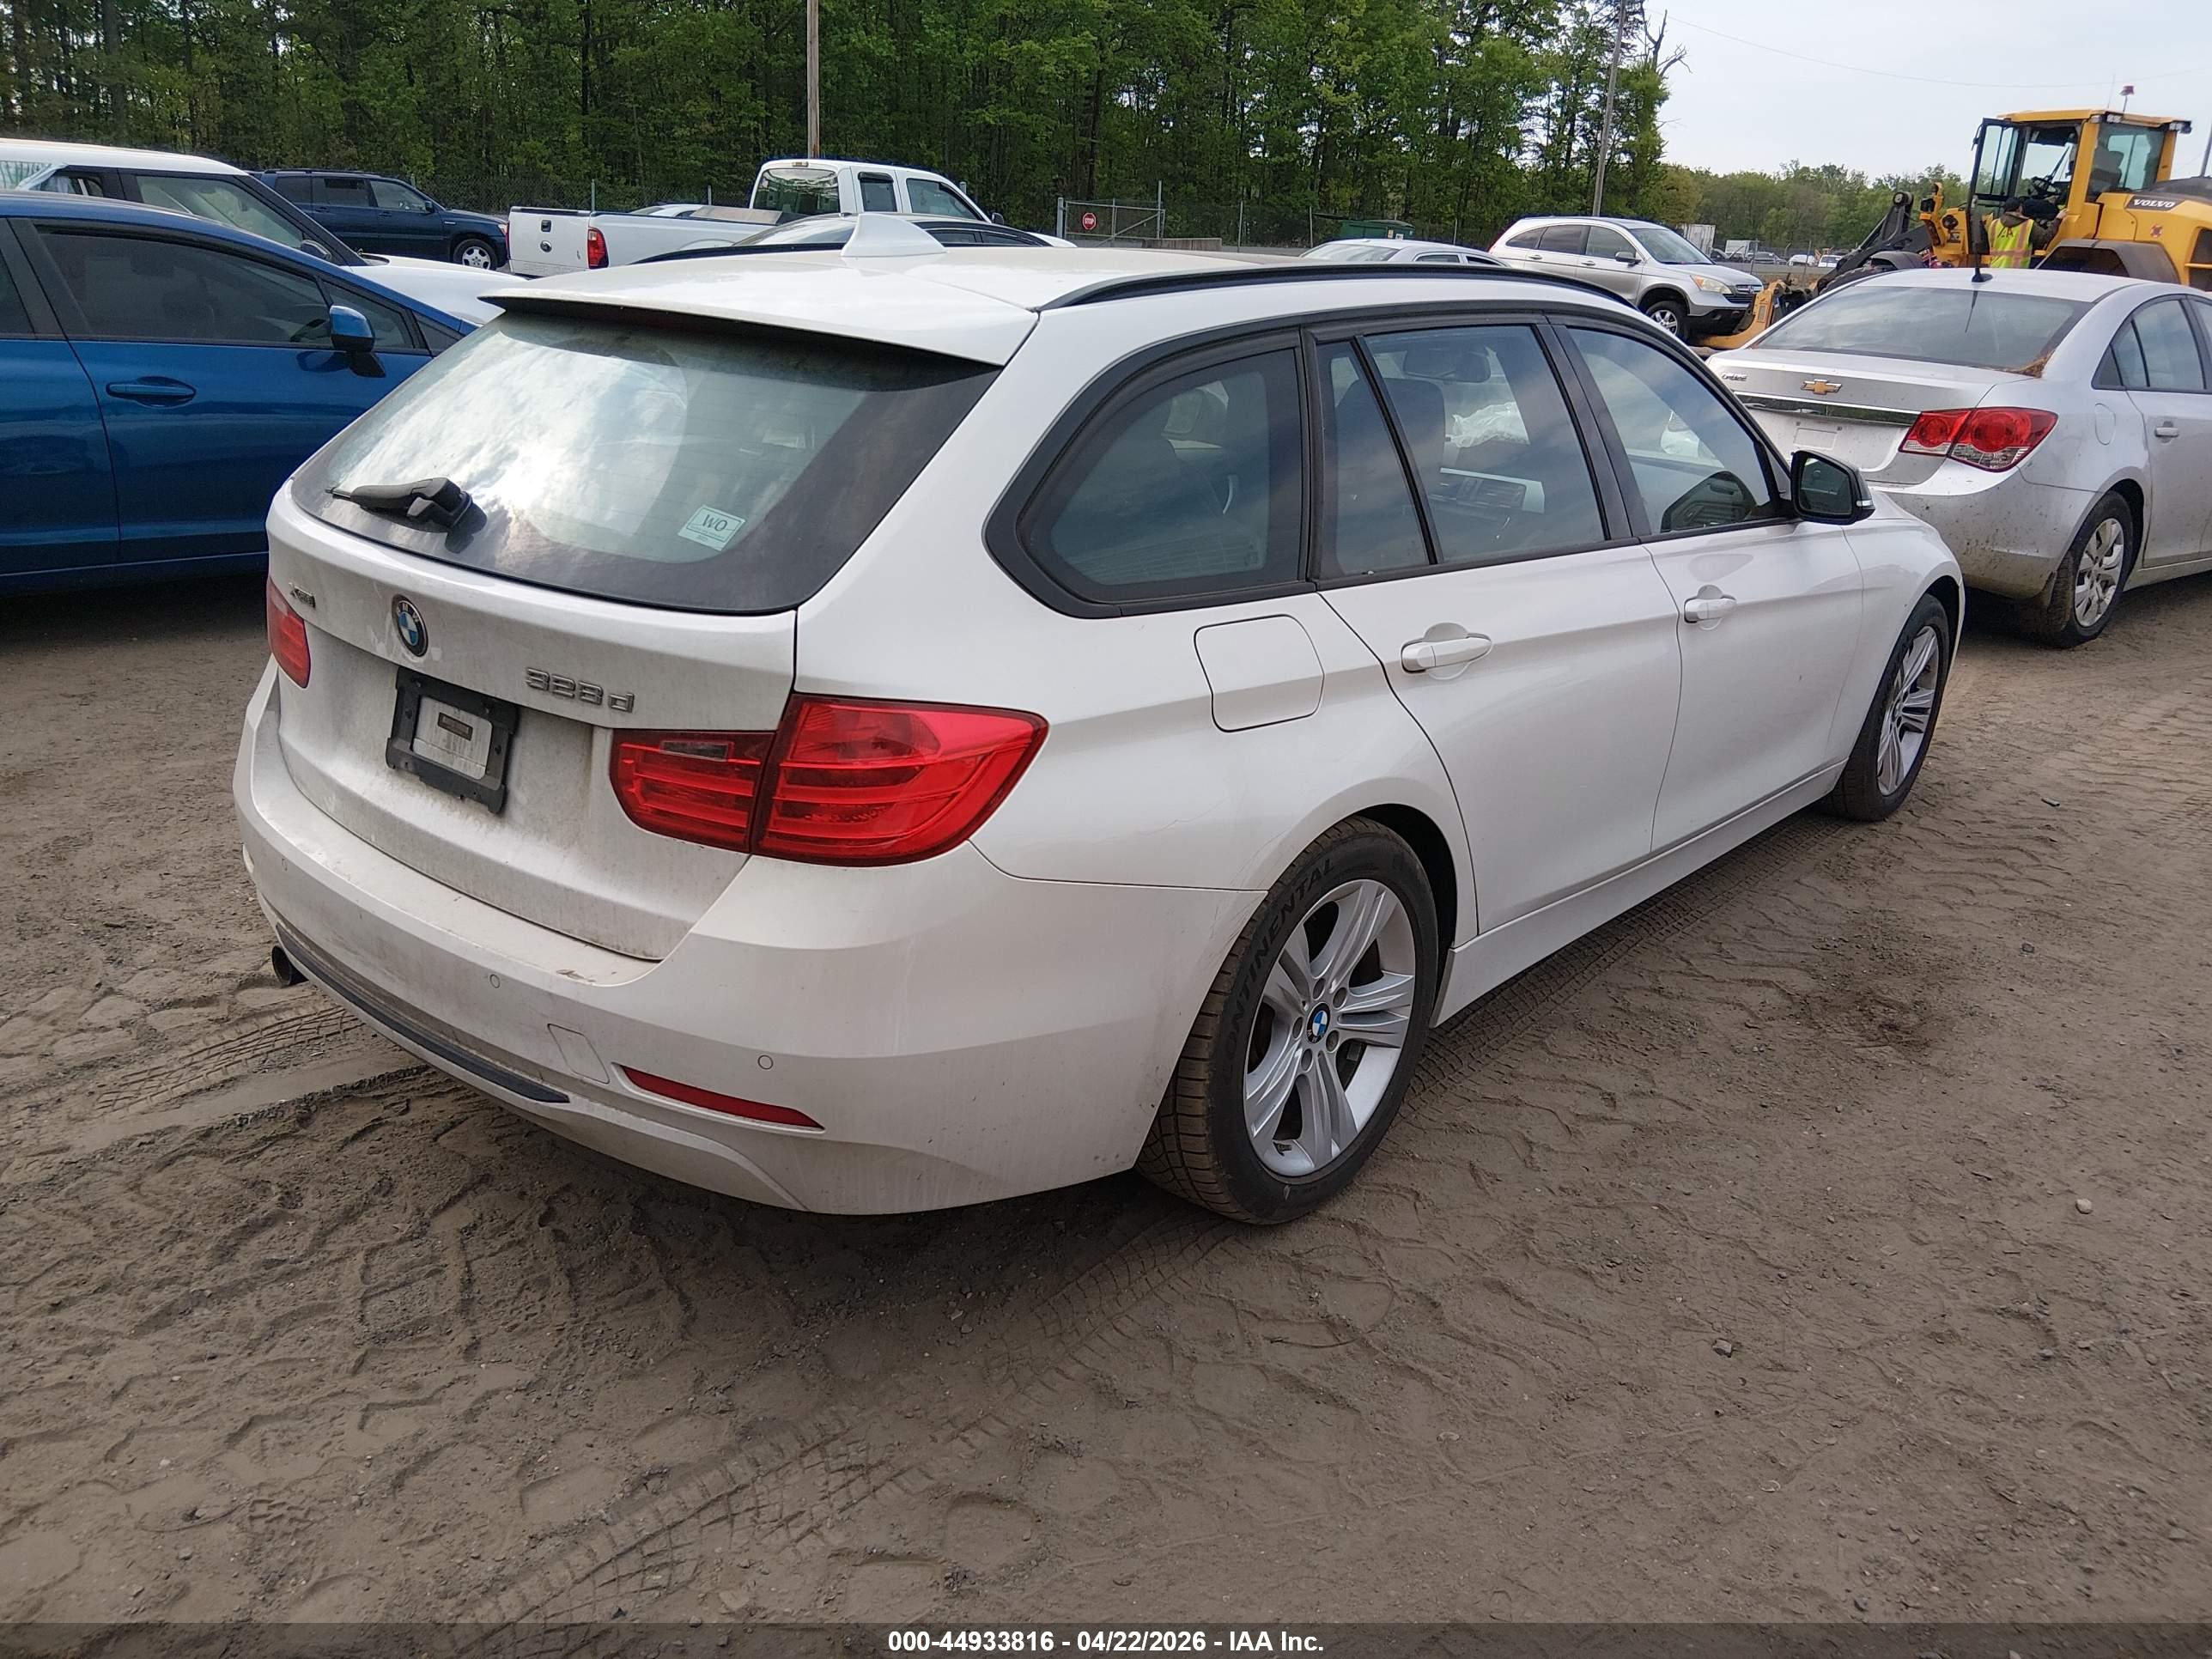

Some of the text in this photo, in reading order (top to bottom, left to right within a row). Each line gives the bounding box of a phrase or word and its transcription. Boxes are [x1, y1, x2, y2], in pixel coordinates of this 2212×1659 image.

[2134, 198, 2175, 208] VOLVO
[702, 514, 728, 532] WO
[525, 666, 635, 714] 328d
